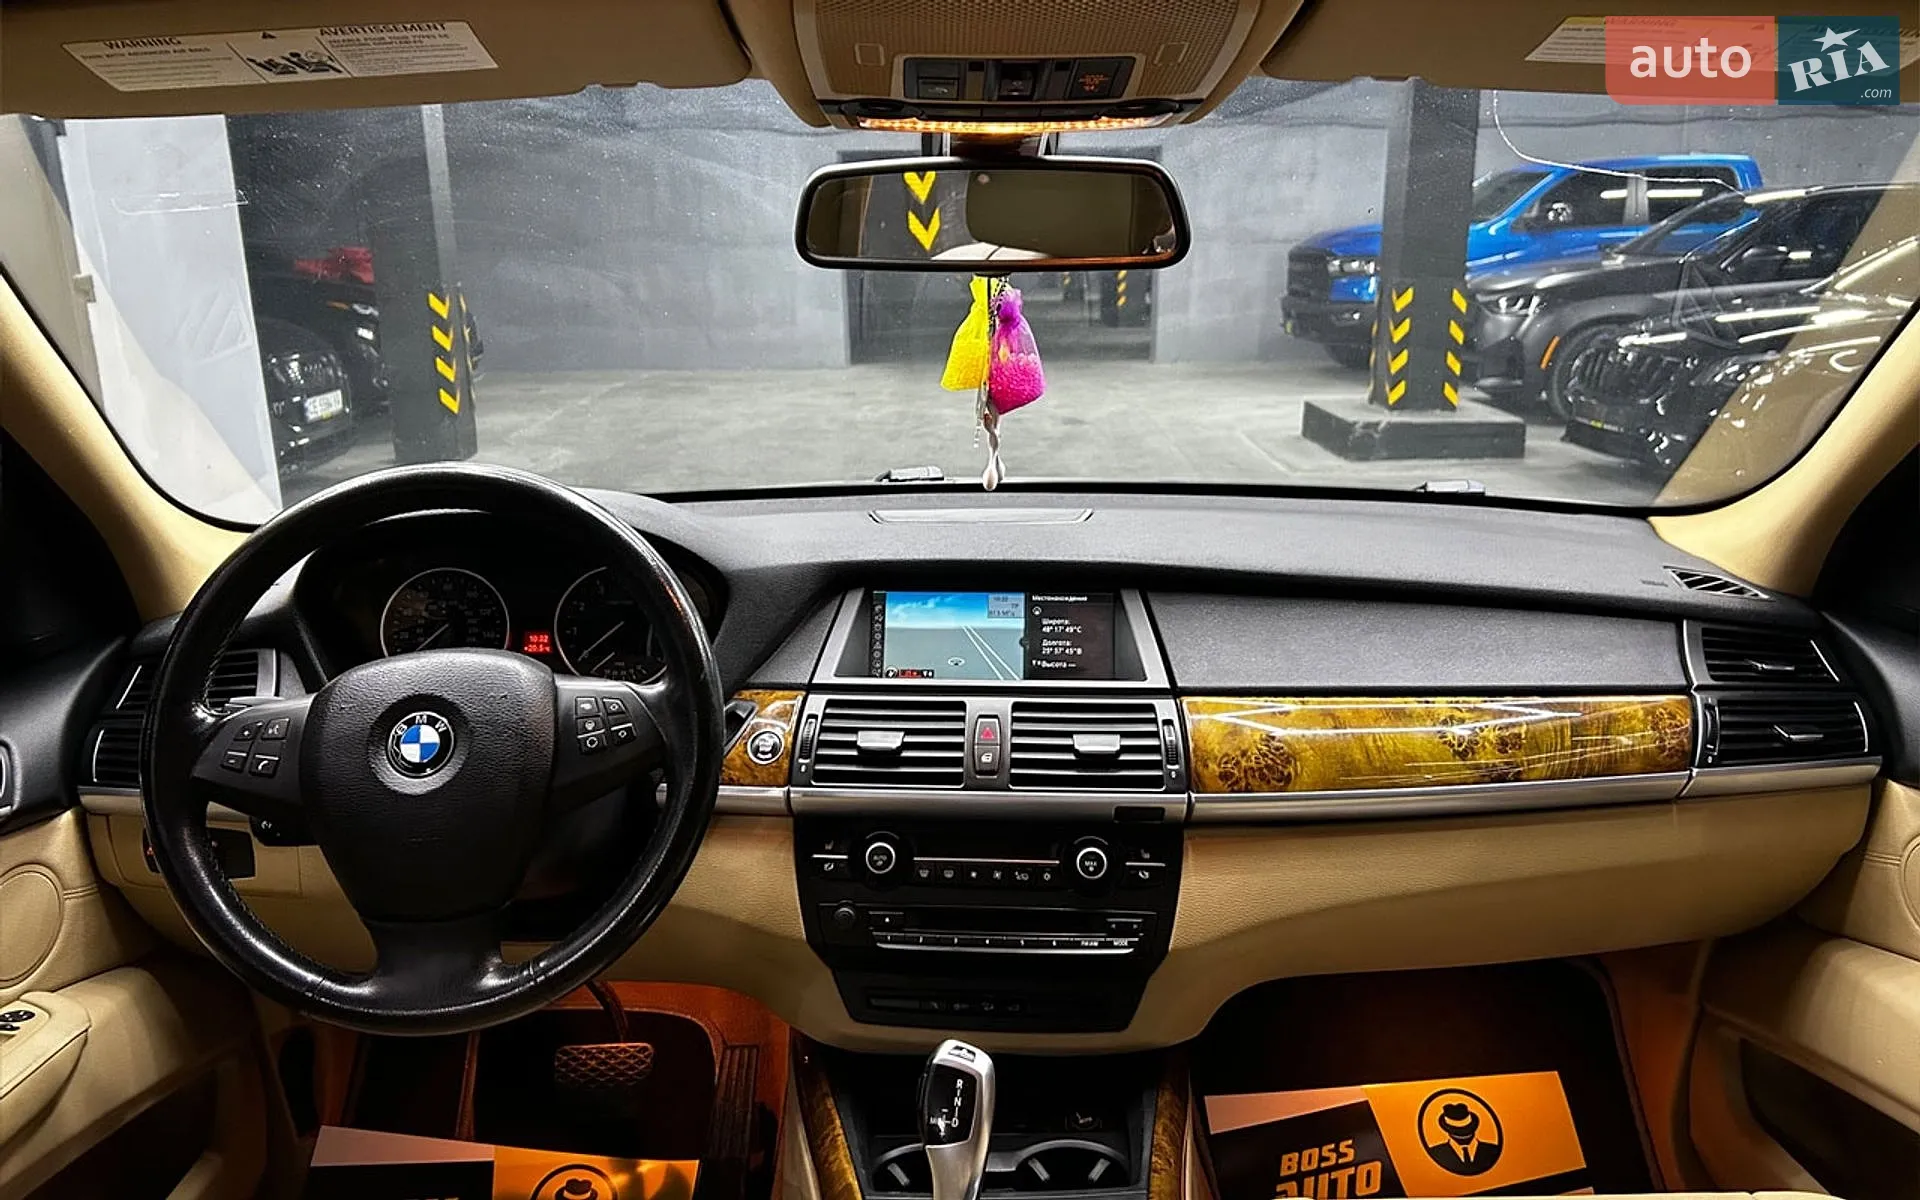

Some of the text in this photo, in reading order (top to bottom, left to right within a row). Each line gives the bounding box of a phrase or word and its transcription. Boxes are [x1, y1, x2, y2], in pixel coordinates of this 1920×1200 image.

[319, 23, 447, 37] AVERTISSEMENT
[103, 37, 182, 50] WARNING
[393, 714, 448, 736] BMW
[956, 1078, 964, 1089] R
[954, 1096, 962, 1107] N
[1280, 1139, 1355, 1177] BOSS
